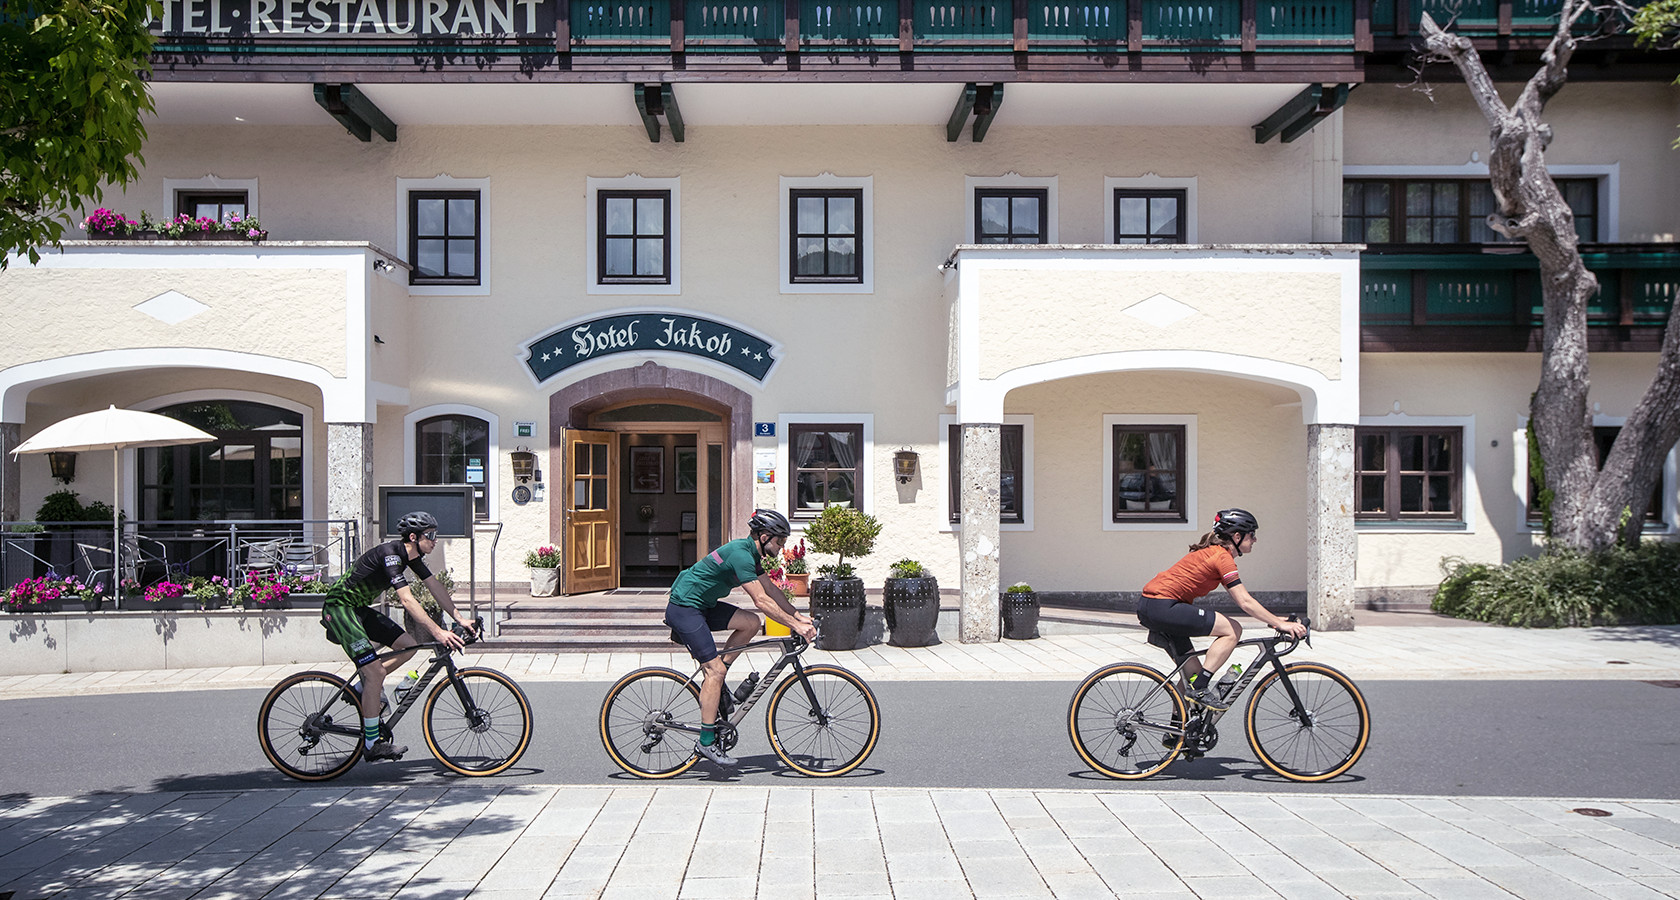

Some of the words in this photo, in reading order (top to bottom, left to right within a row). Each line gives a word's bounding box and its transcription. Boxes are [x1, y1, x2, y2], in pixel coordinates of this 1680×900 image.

[250, 0, 545, 34] RESTAURANT
[571, 319, 640, 359] Hotel
[655, 317, 732, 357] Jakob
[761, 423, 769, 433] 3
[742, 668, 782, 712] CANYON
